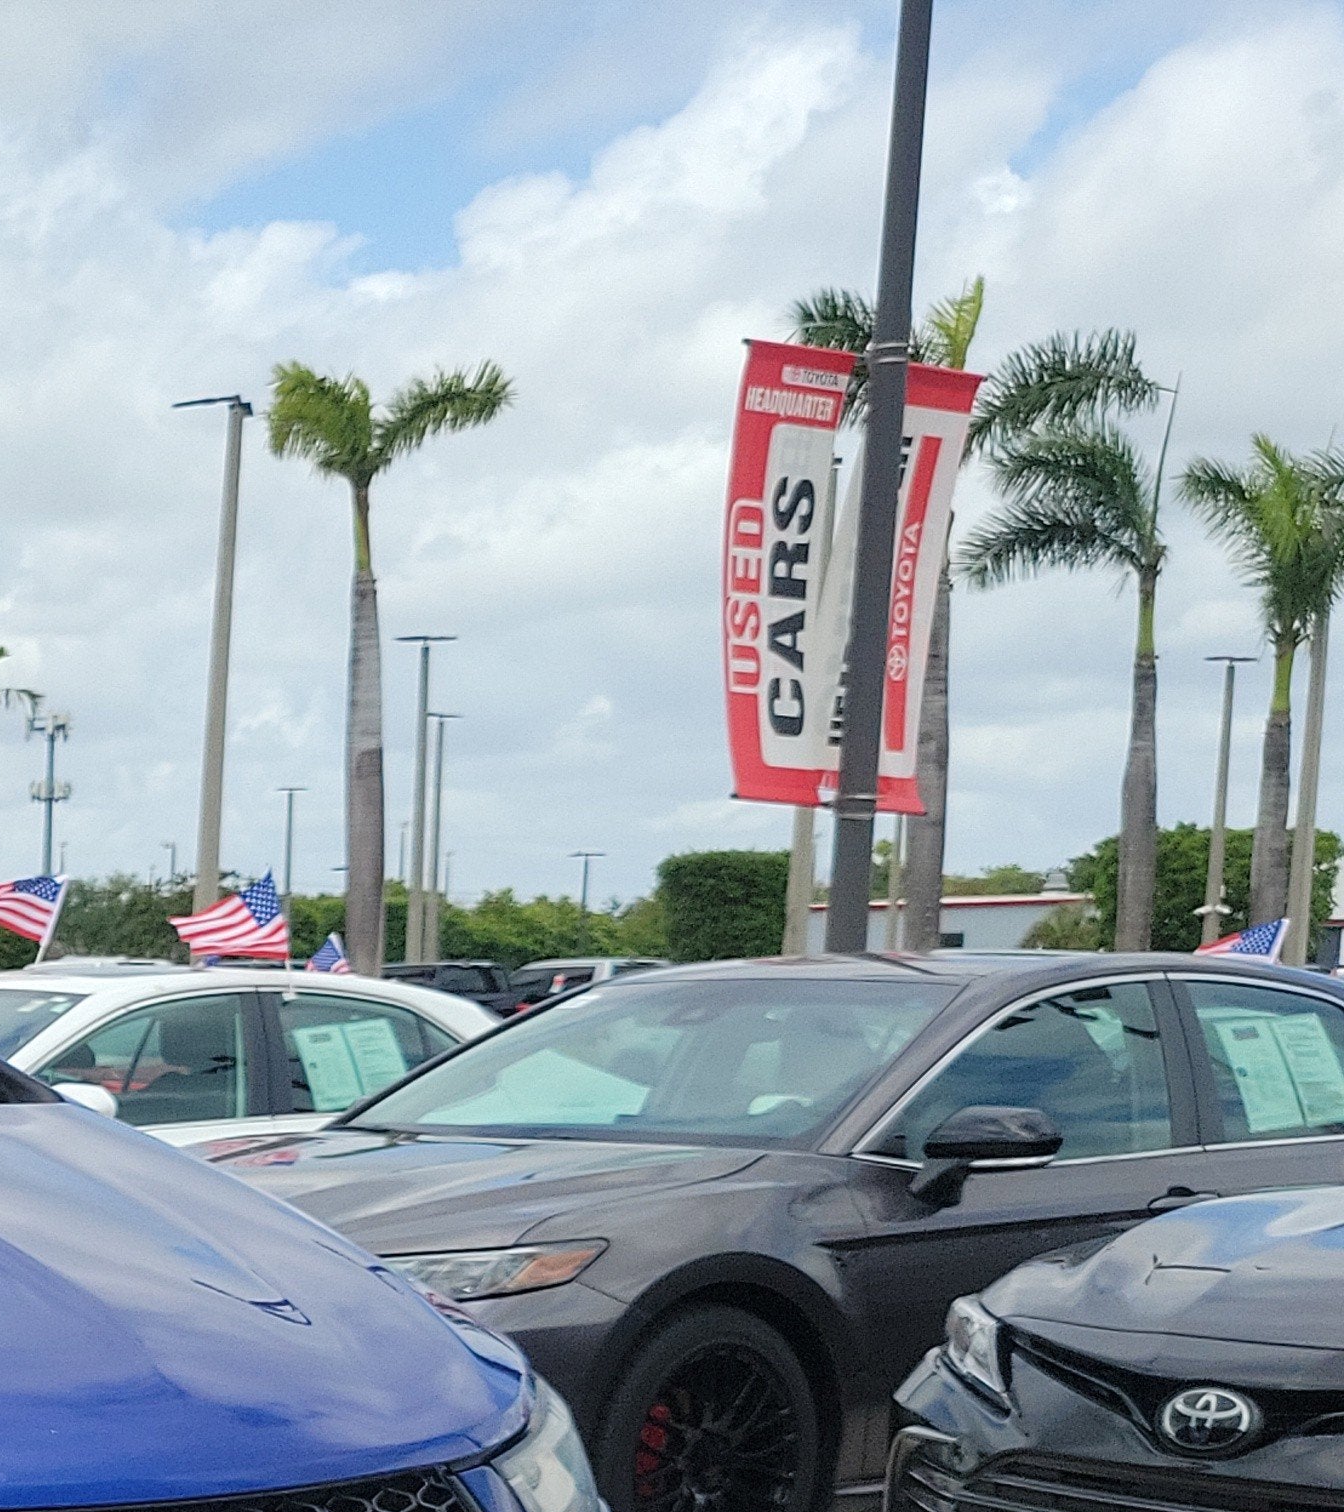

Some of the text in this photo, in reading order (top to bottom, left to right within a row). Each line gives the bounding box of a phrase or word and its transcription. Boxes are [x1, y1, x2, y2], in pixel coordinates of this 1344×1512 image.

[745, 386, 835, 421] HEADQUARTER
[802, 370, 839, 386] TOYOTA
[729, 508, 764, 691] USED
[767, 475, 815, 737] CARS
[891, 522, 921, 639] TOYOTA
